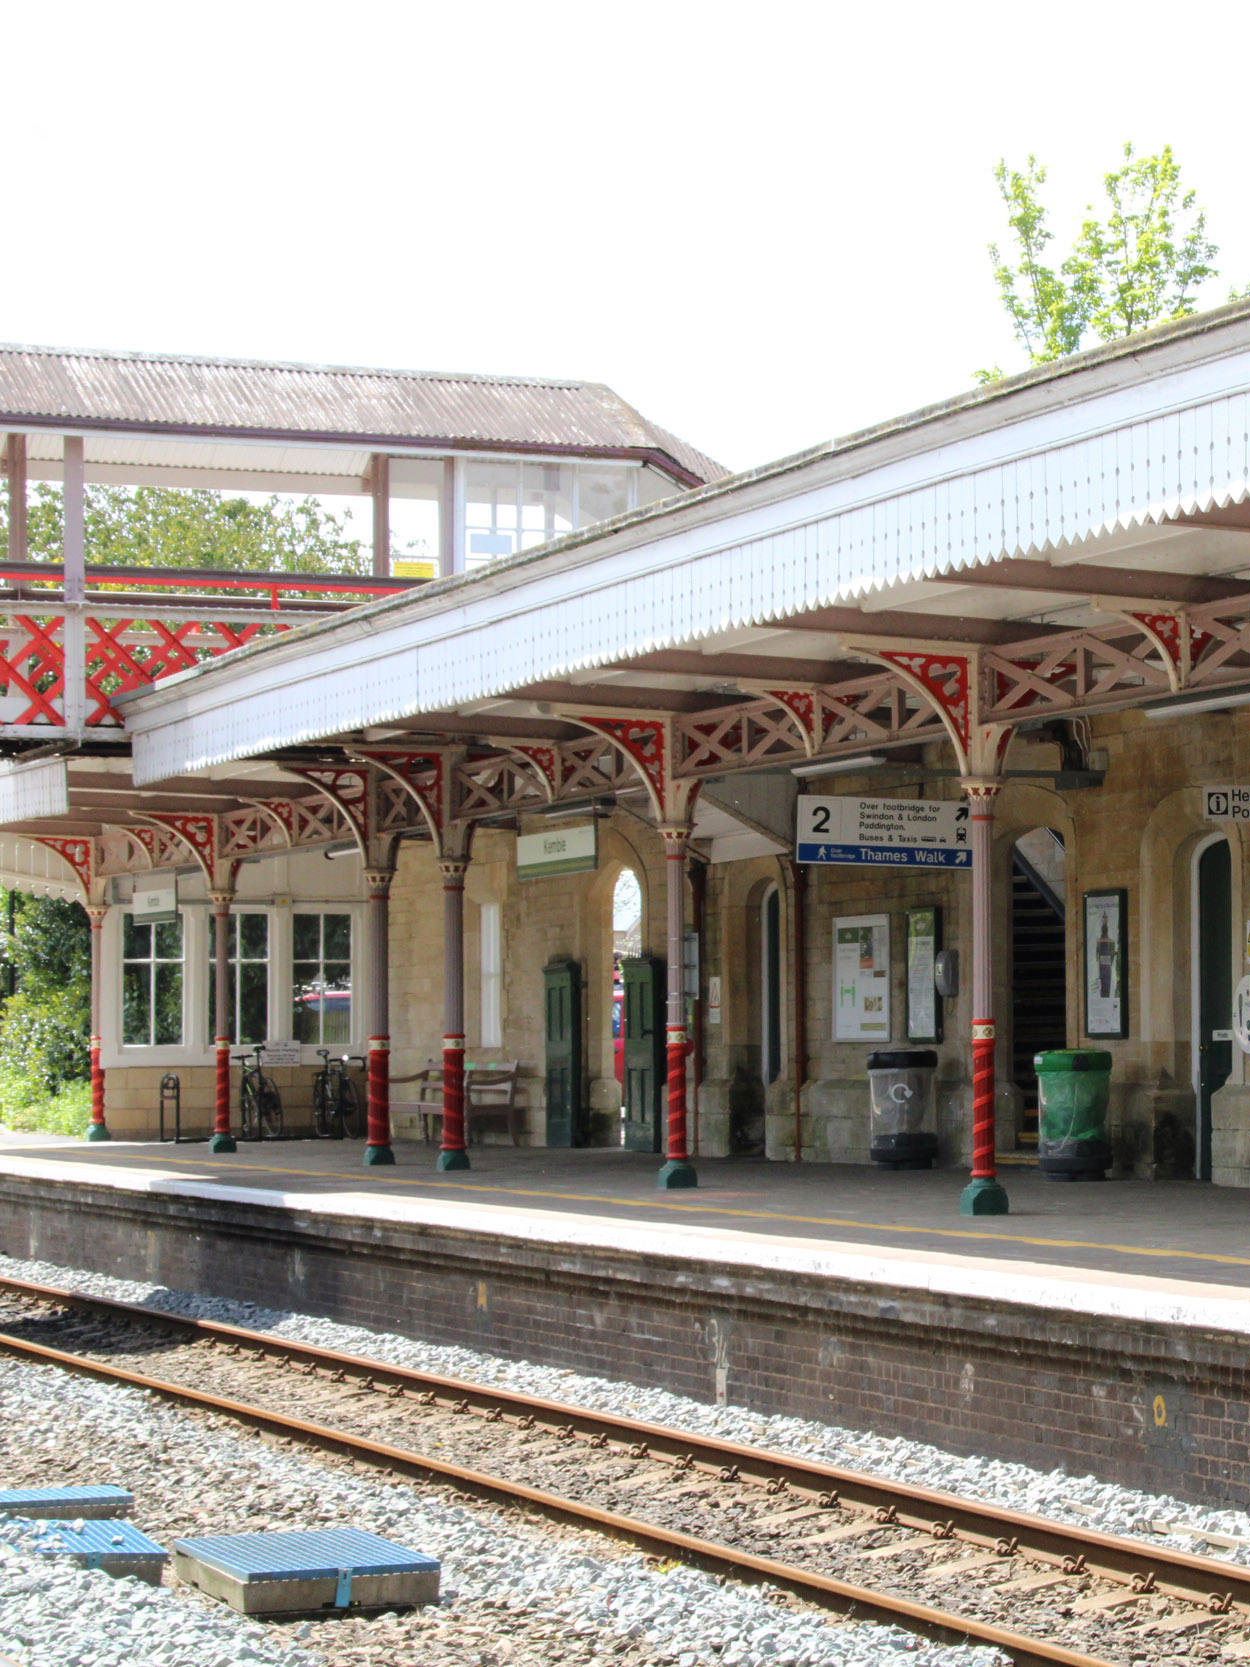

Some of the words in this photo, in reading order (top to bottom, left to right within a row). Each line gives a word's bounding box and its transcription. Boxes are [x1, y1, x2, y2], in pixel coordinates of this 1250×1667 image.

[860, 802, 879, 811] Over
[883, 803, 925, 814] footbridge
[929, 805, 940, 813] for
[812, 806, 831, 833] 2
[860, 812, 894, 821] Swindon
[907, 814, 937, 822] London
[859, 822, 906, 832] Paddington.
[859, 834, 884, 842] Buses
[898, 835, 918, 843] Taxis
[860, 848, 908, 862] Thames
[915, 851, 946, 863] Walk
